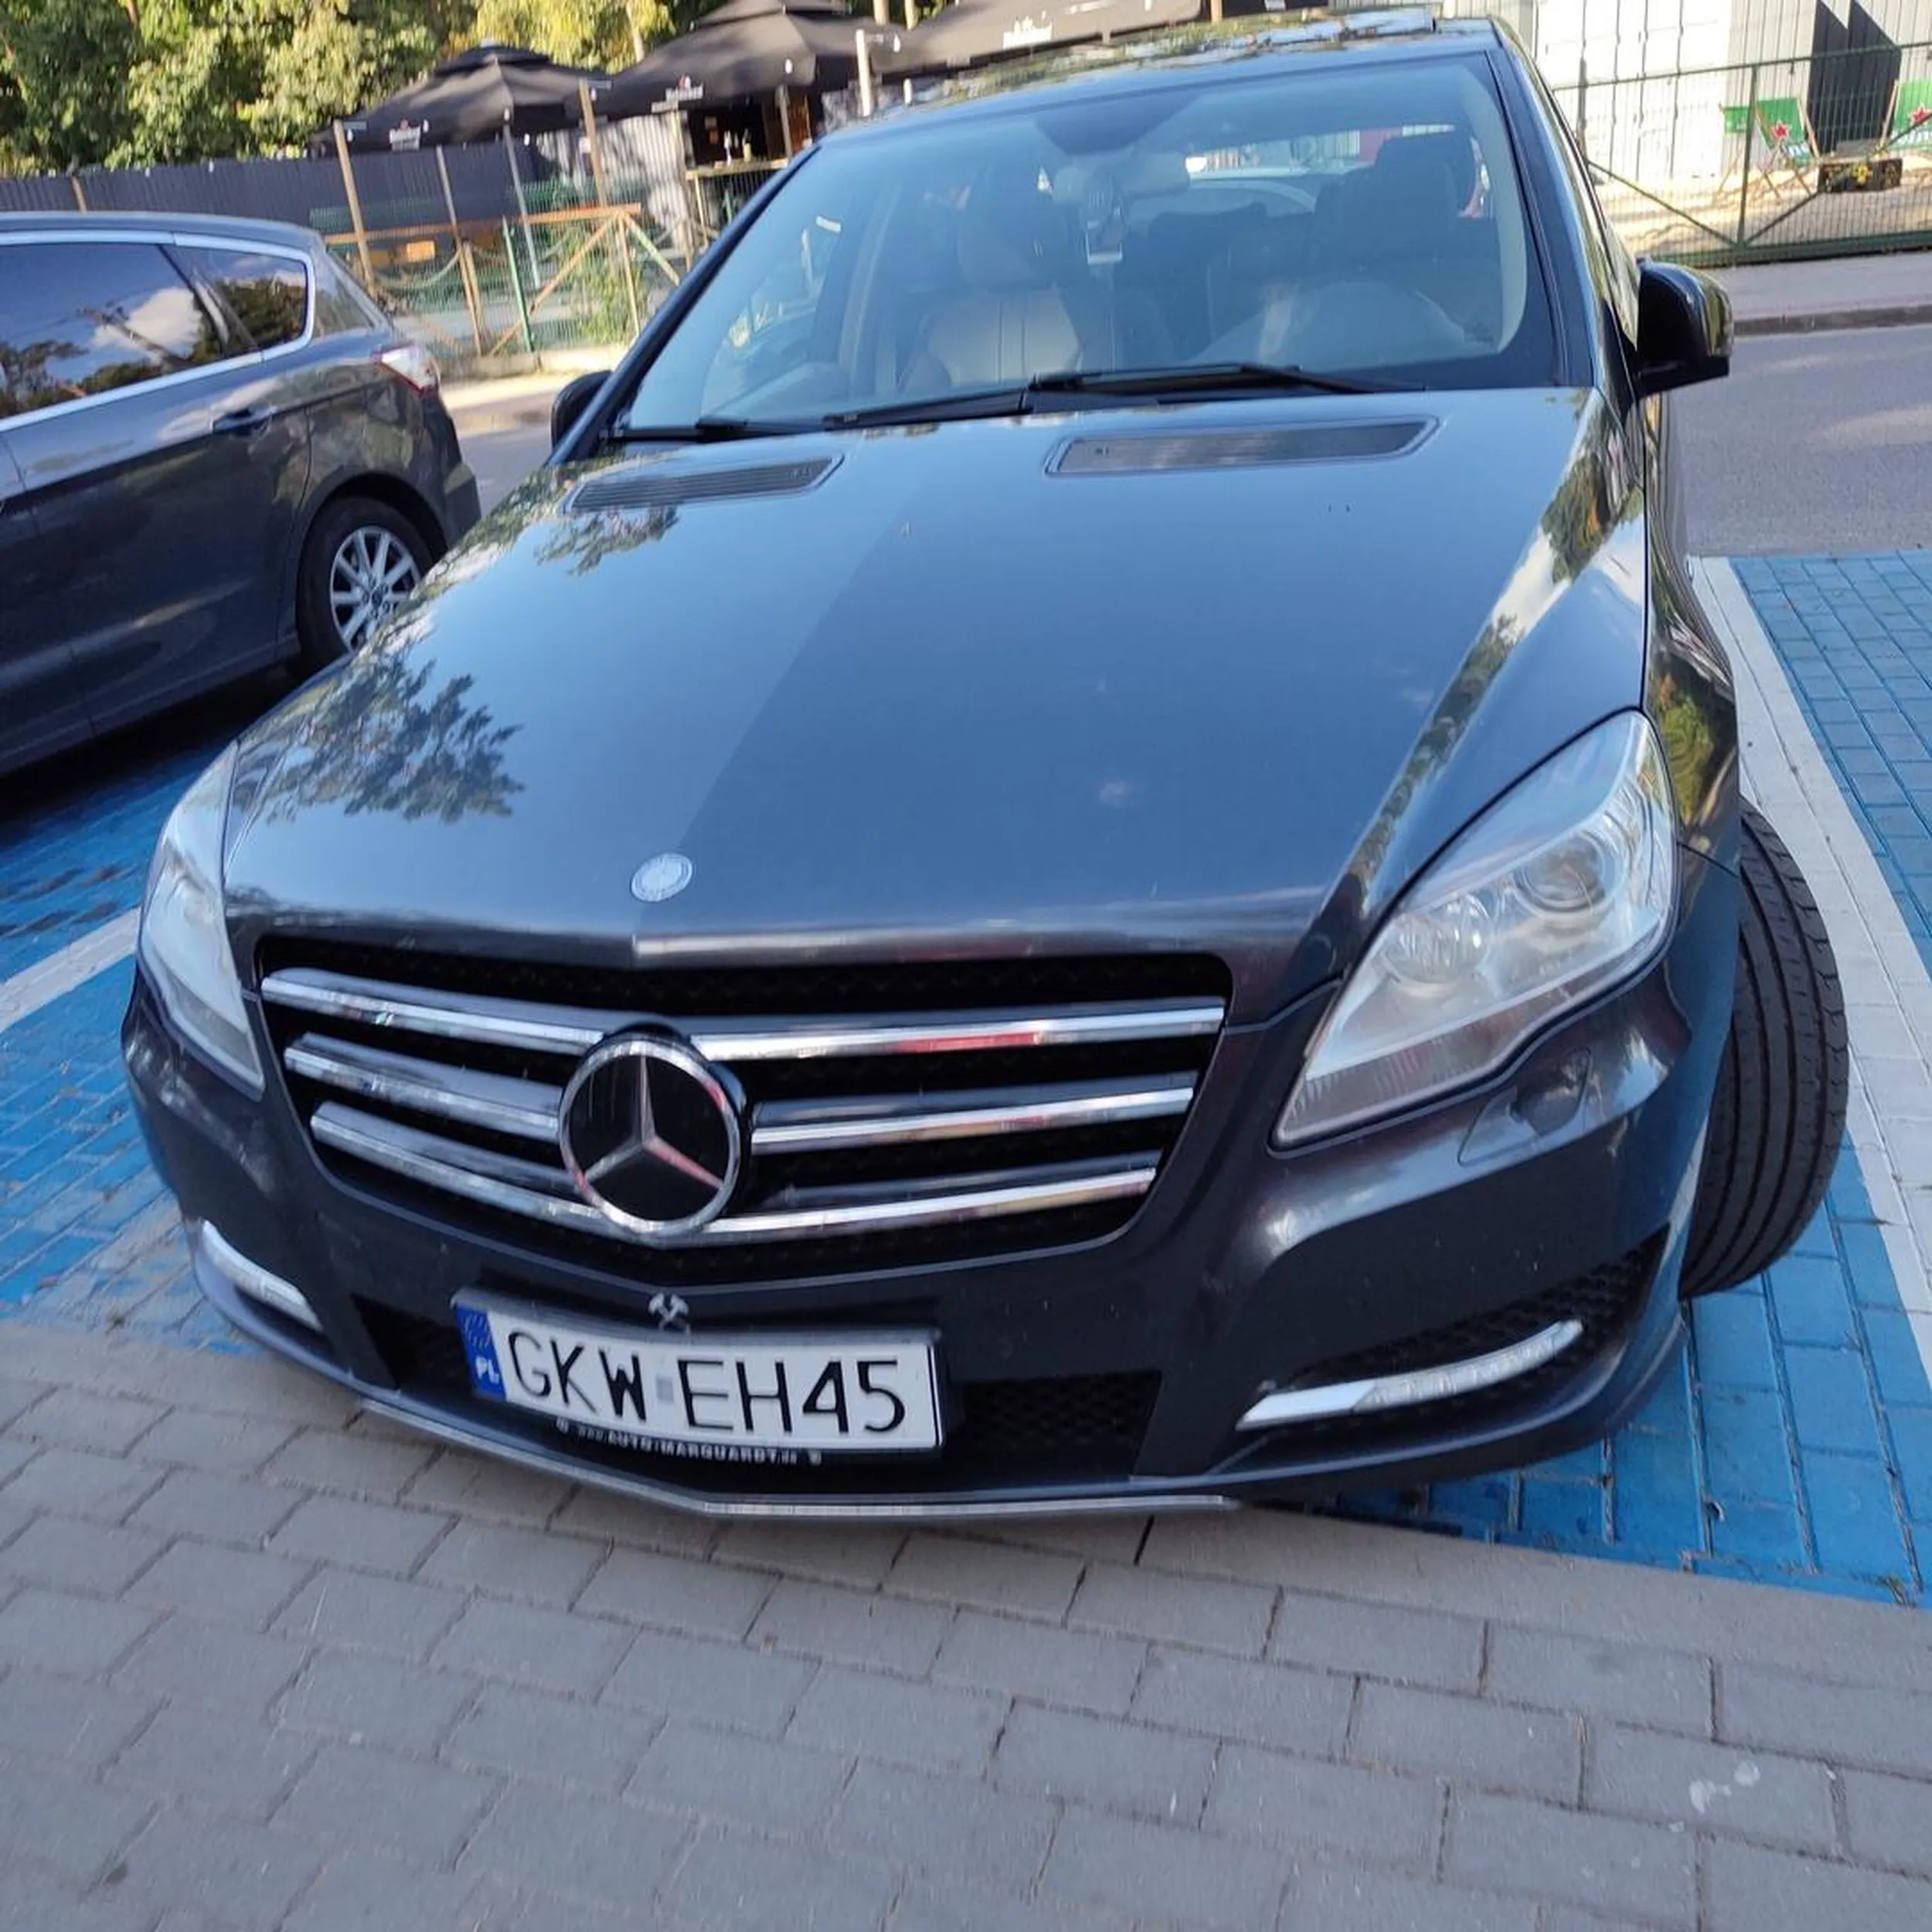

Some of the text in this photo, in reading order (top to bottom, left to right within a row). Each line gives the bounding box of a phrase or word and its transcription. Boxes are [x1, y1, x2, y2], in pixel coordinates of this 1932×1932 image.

[475, 1356, 499, 1383] PL
[508, 1331, 905, 1434] GKW EH45
